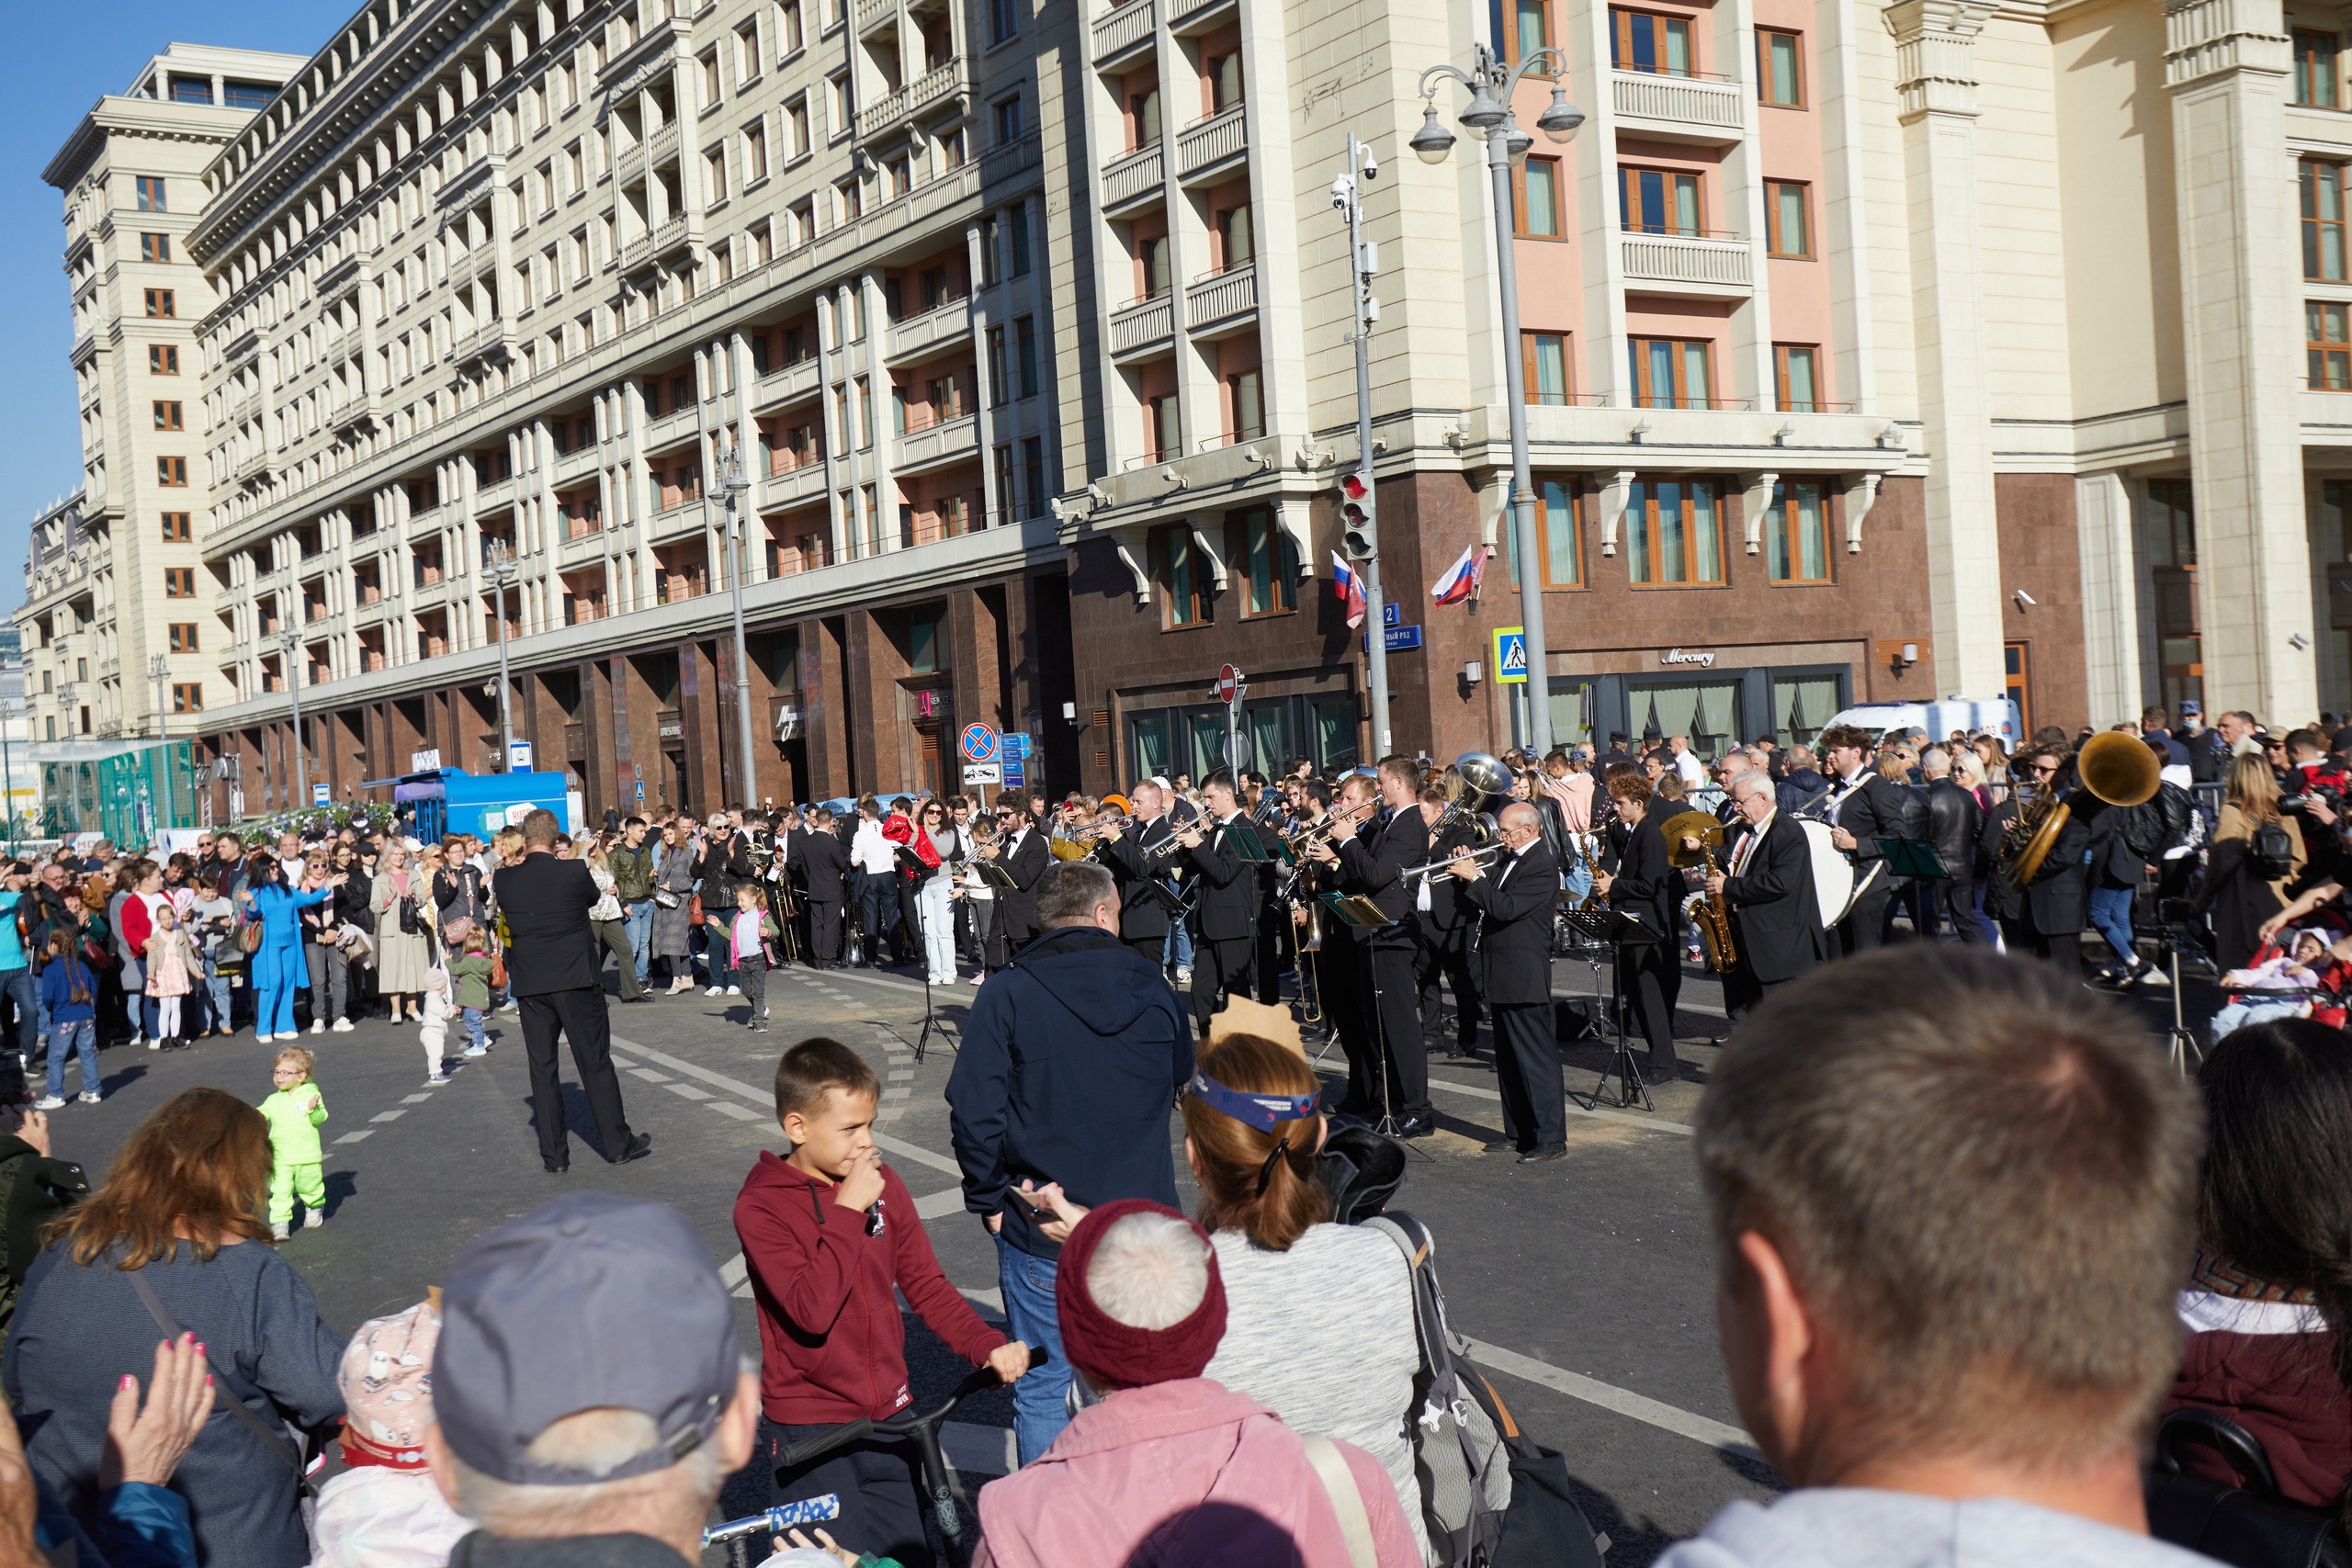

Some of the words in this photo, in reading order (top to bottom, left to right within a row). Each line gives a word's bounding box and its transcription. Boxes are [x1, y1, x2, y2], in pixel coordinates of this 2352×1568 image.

[1385, 607, 1393, 622] 2
[1399, 631, 1410, 639] РЯД
[1661, 648, 1715, 667] Mercury
[1980, 725, 1996, 736] 103
[1668, 820, 1691, 837] SABIAN
